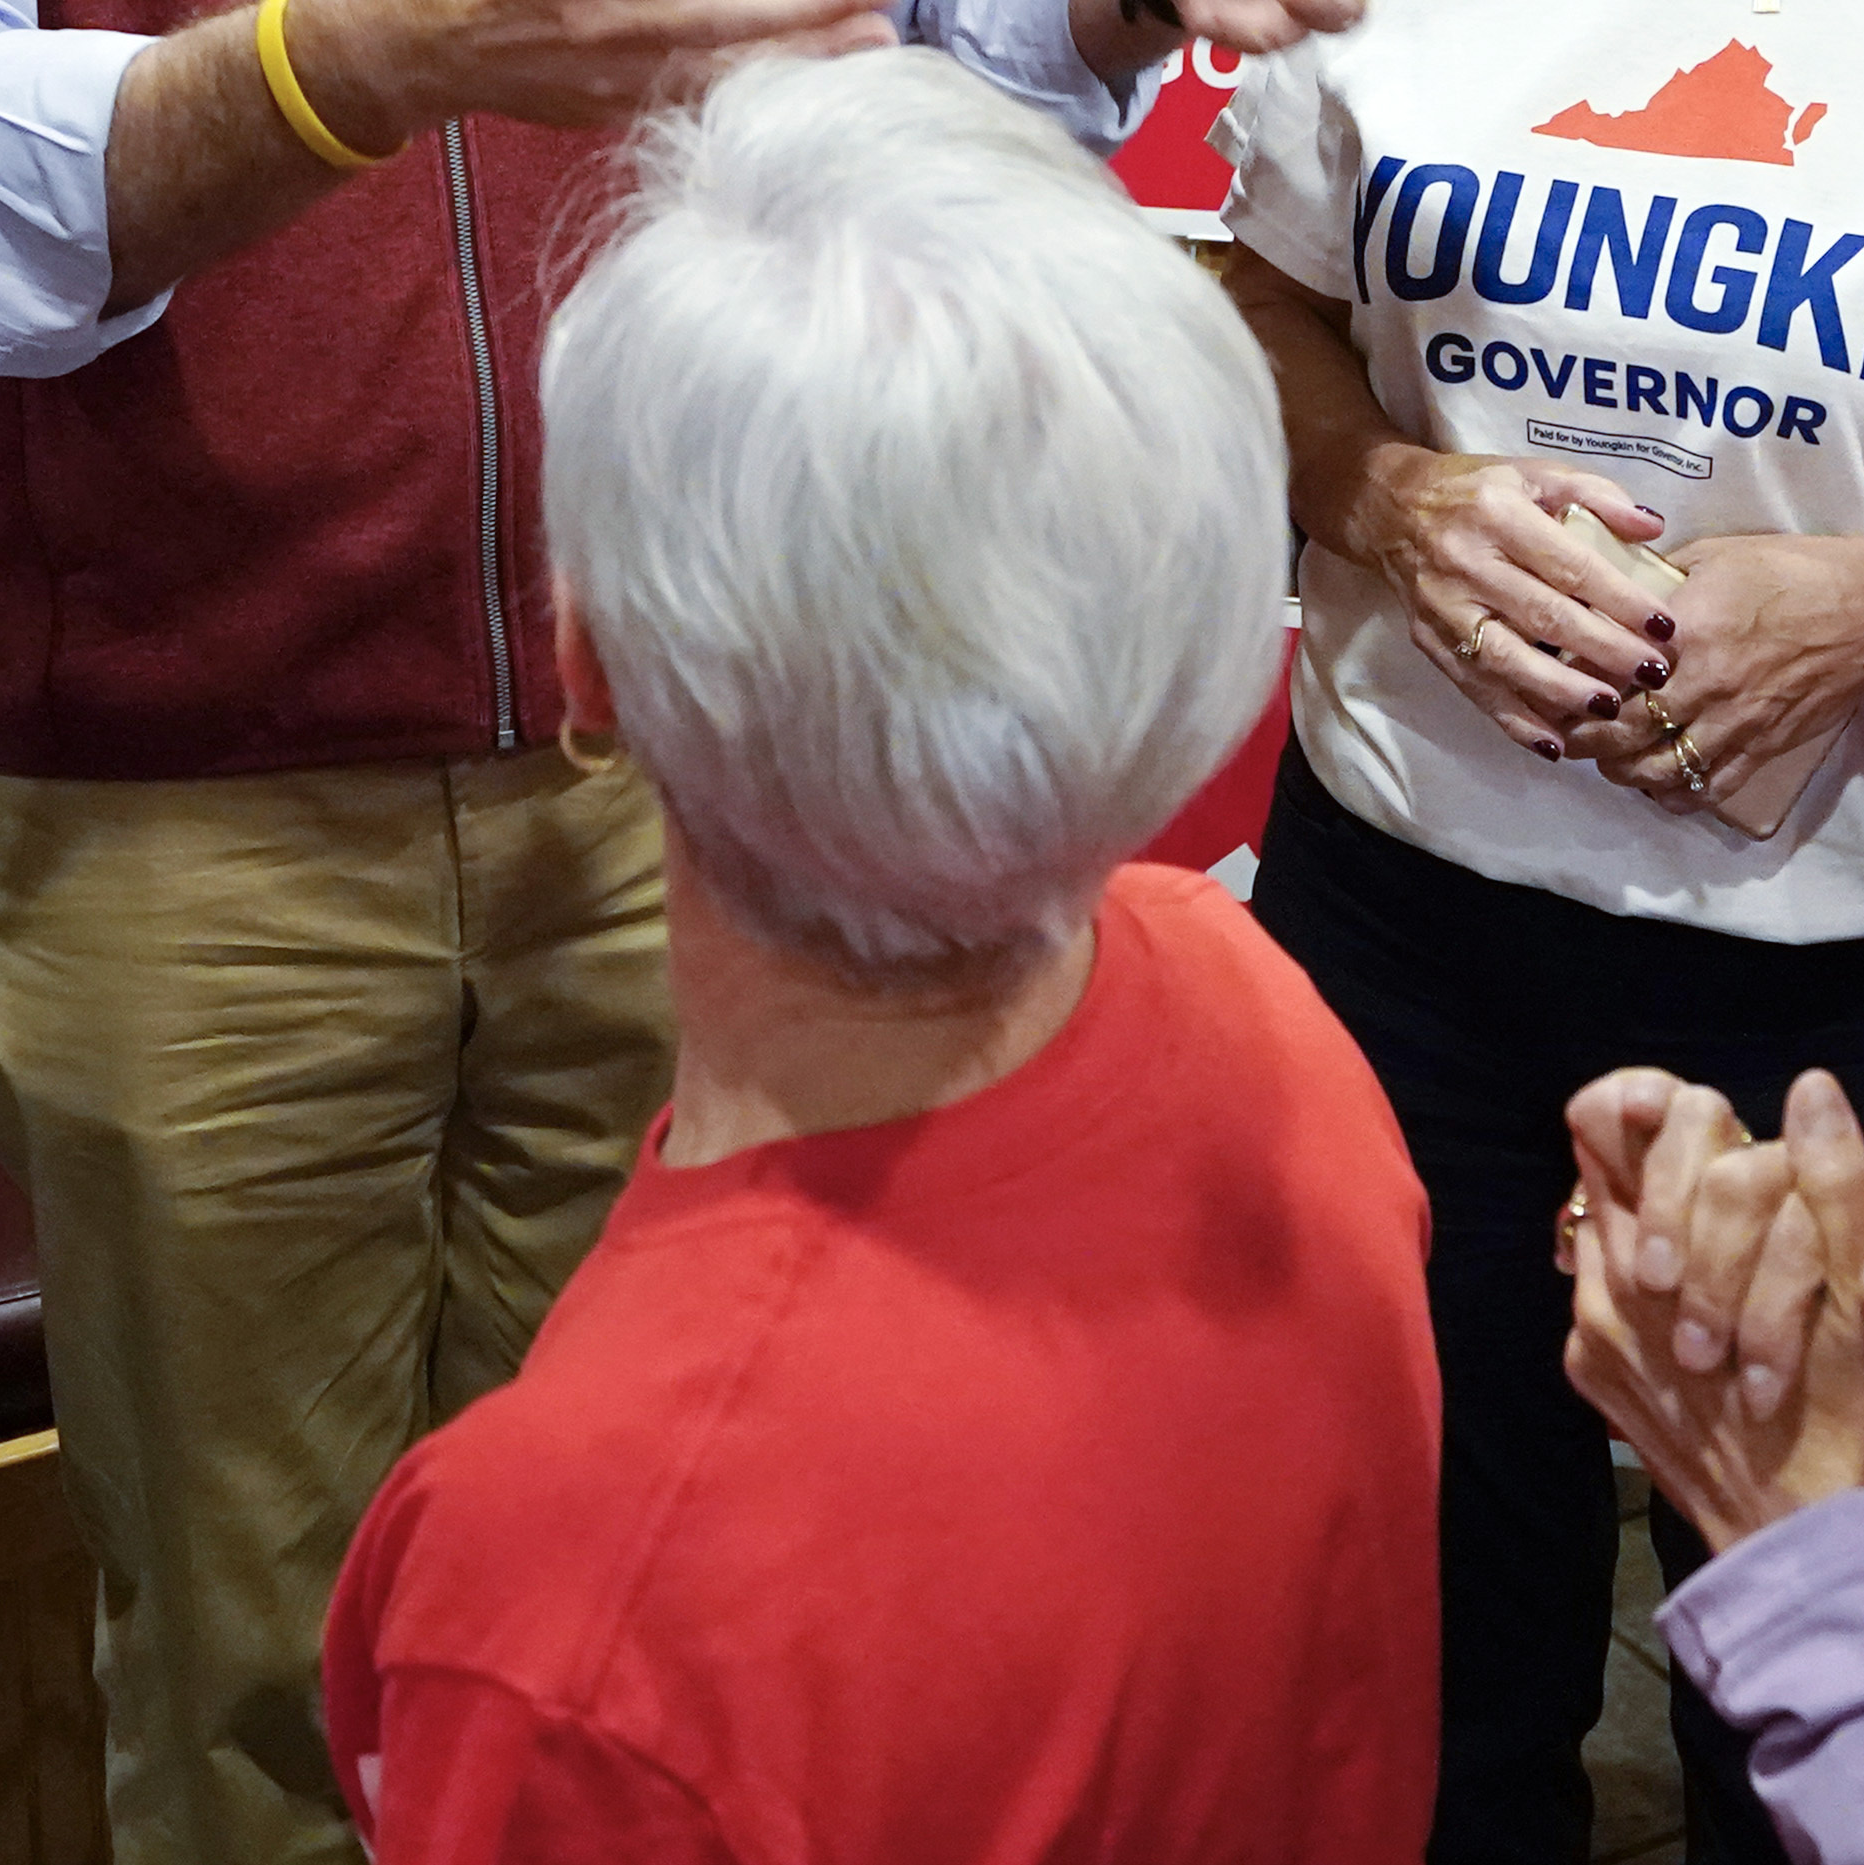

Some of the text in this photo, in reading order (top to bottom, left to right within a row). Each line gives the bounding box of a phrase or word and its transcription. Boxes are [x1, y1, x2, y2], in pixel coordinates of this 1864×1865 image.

[1425, 332, 1829, 445] GOVERNOR
[1556, 431, 1570, 442] for
[1571, 433, 1584, 447] by
[1636, 442, 1650, 454] for
